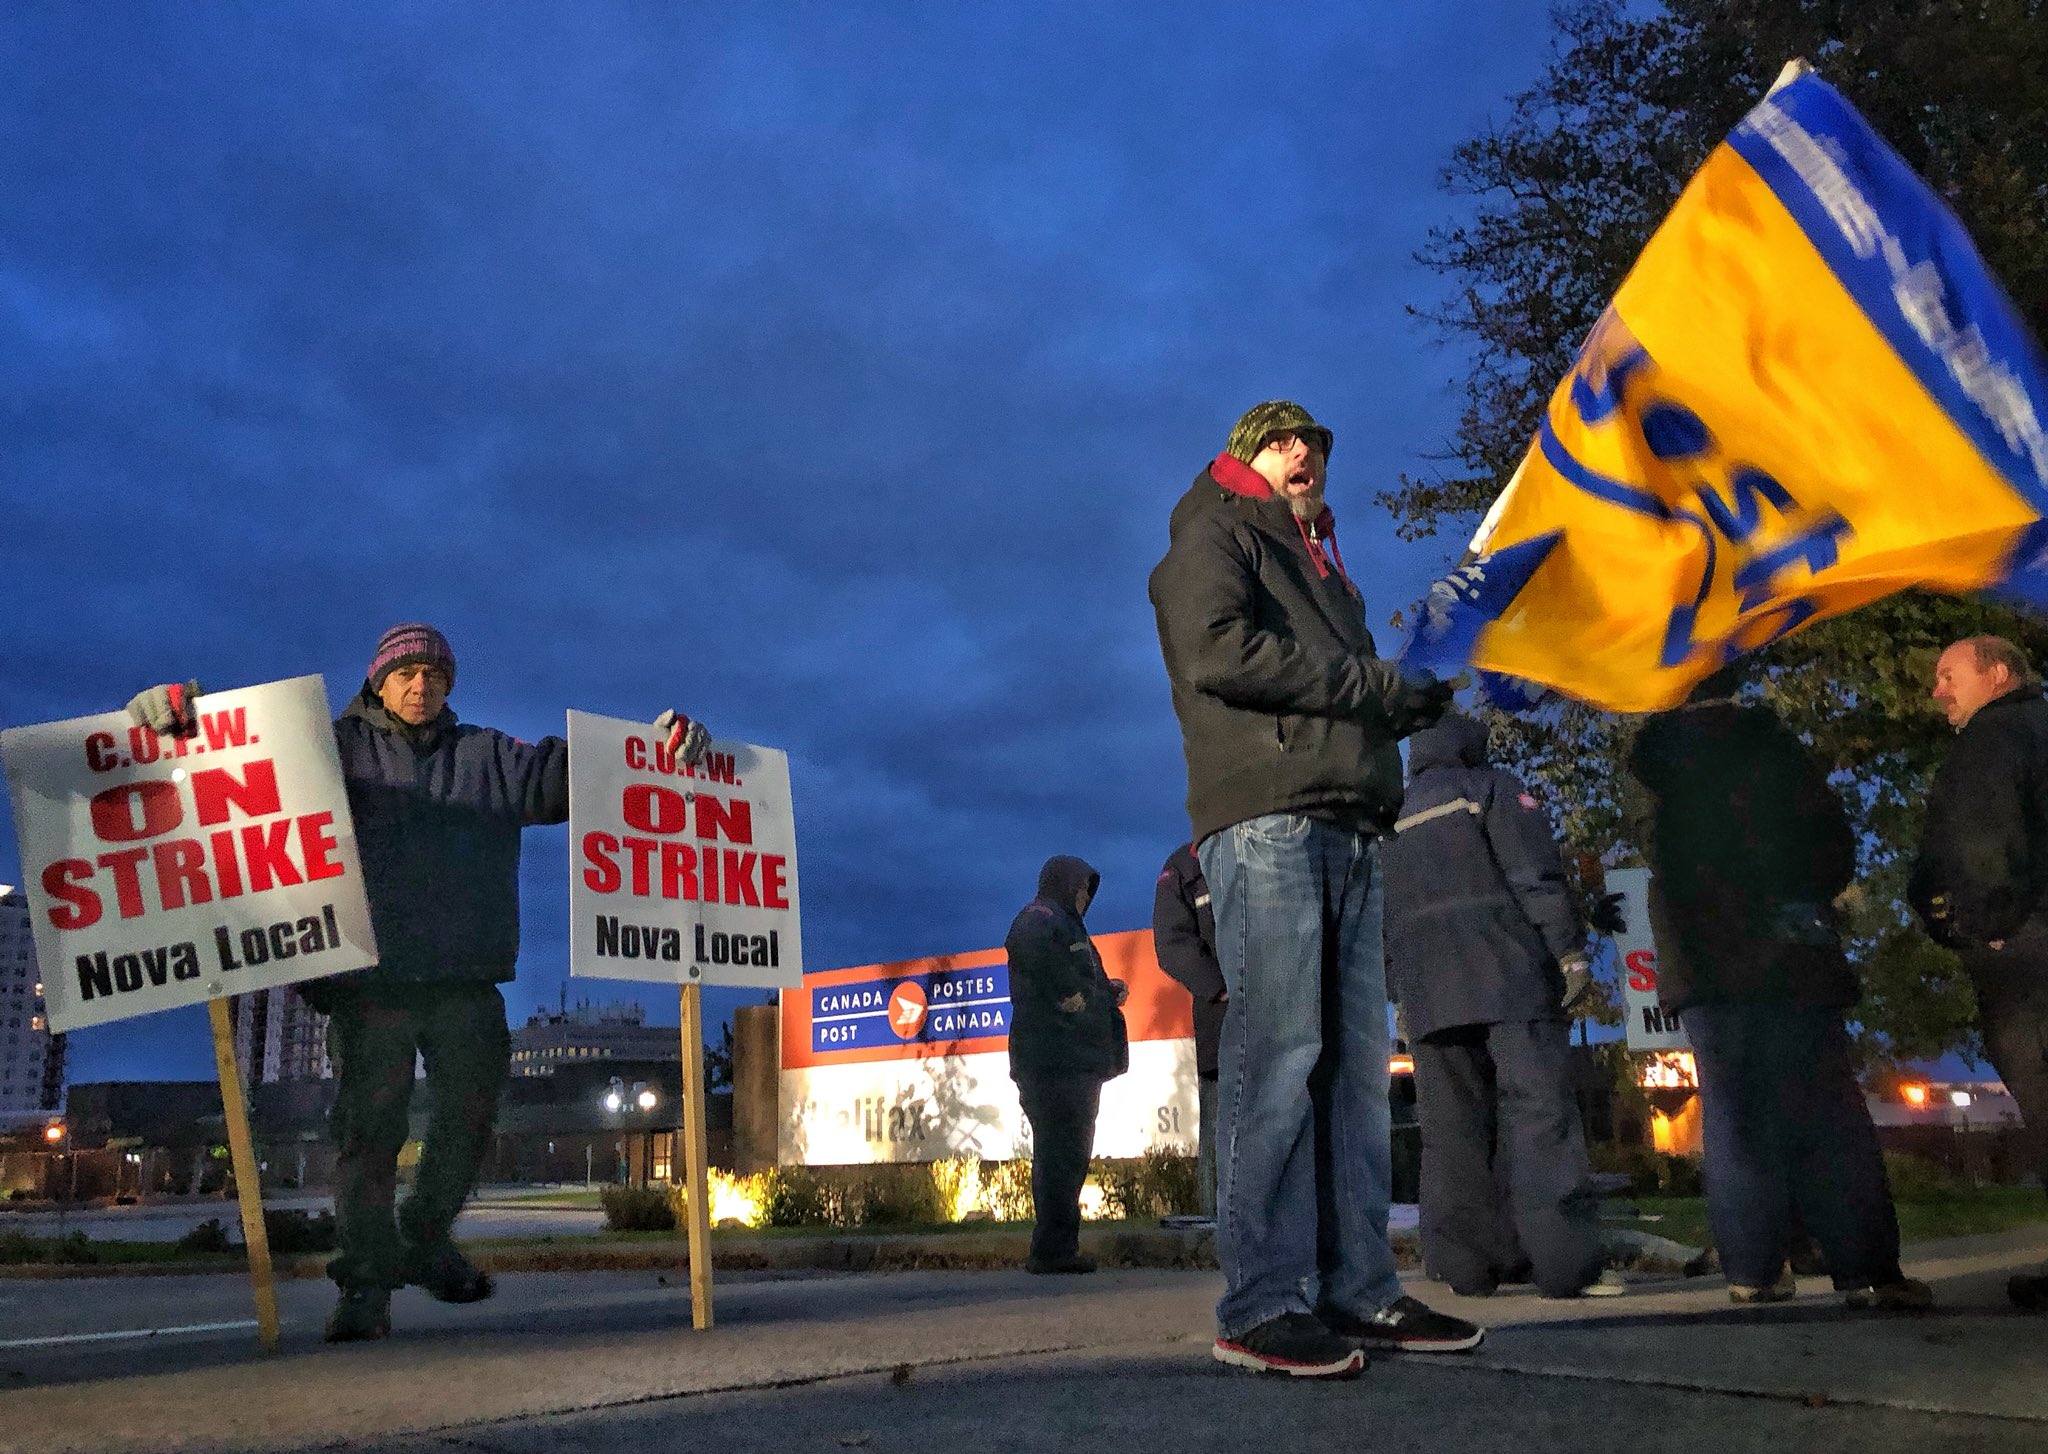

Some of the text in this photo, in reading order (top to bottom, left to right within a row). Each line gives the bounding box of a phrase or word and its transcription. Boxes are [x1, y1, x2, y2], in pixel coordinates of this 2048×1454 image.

[90, 758, 282, 843] ON
[622, 783, 753, 845] ON
[41, 811, 345, 931] STRIKE
[582, 831, 790, 911] STRIKE
[75, 904, 341, 1001] Nova Local
[596, 915, 779, 968] Nova Local
[821, 990, 883, 1012] CANADA
[934, 977, 994, 999] POSTES
[820, 1025, 858, 1042] POST
[934, 1010, 1004, 1032] CANADA
[1157, 1105, 1182, 1134] St
